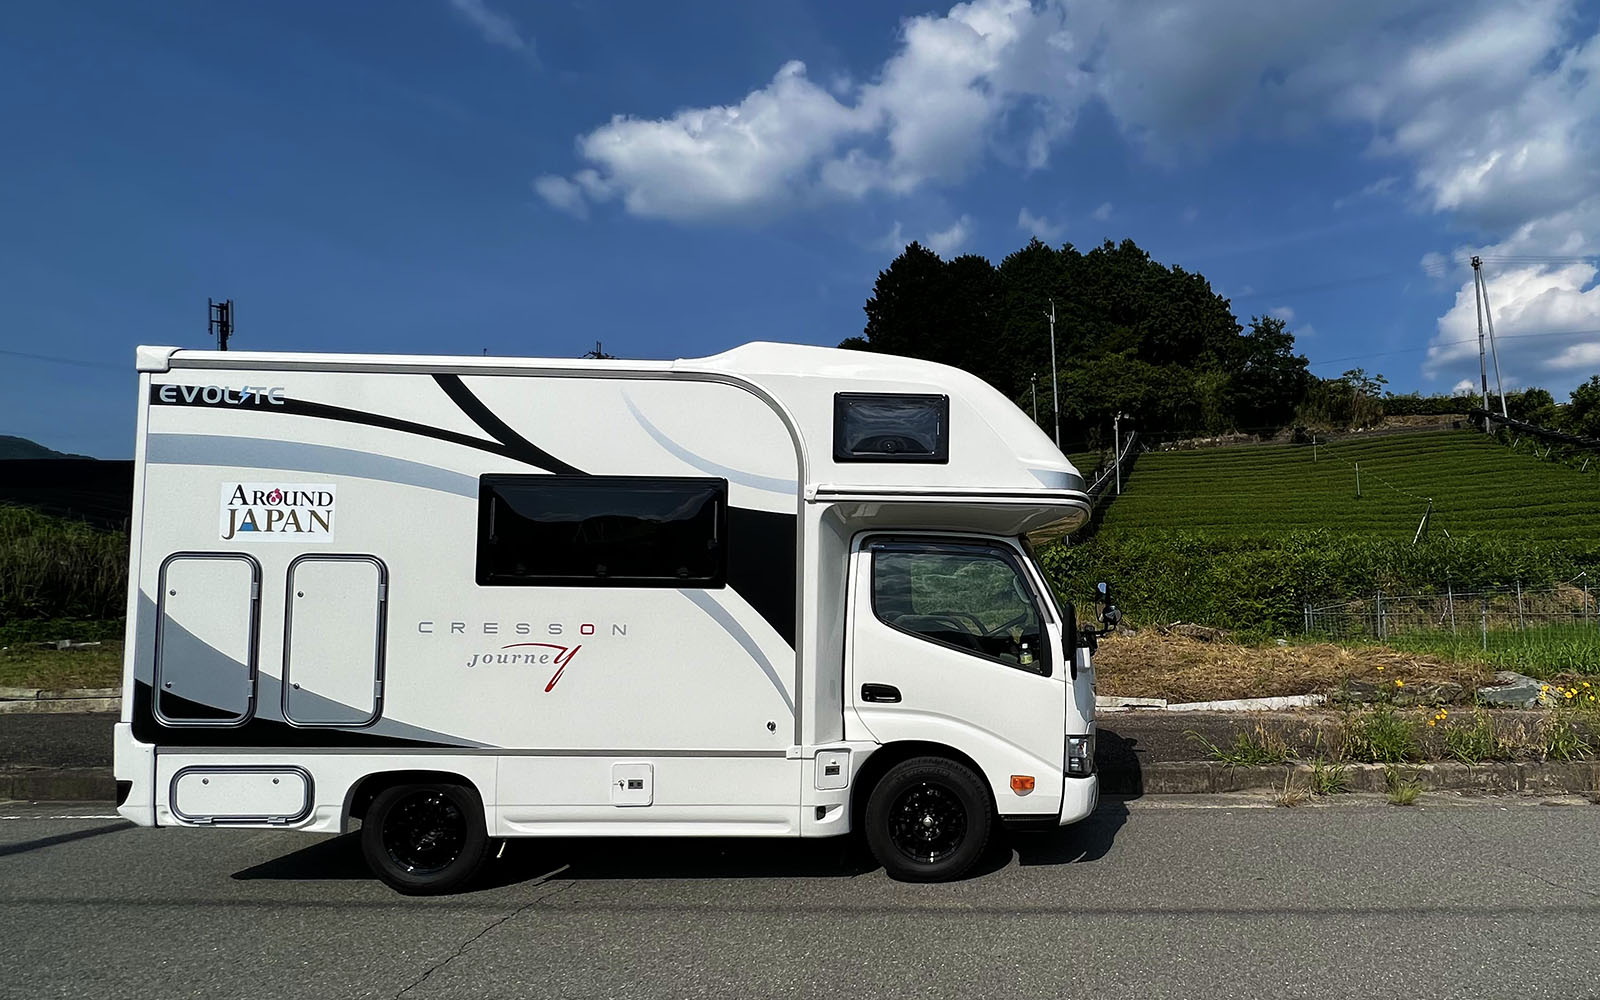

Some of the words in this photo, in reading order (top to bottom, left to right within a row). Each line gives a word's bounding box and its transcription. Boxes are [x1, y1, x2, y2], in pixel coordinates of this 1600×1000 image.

[228, 484, 334, 507] AROUND
[221, 508, 333, 540] JAPAN
[418, 622, 627, 636] CRESSON
